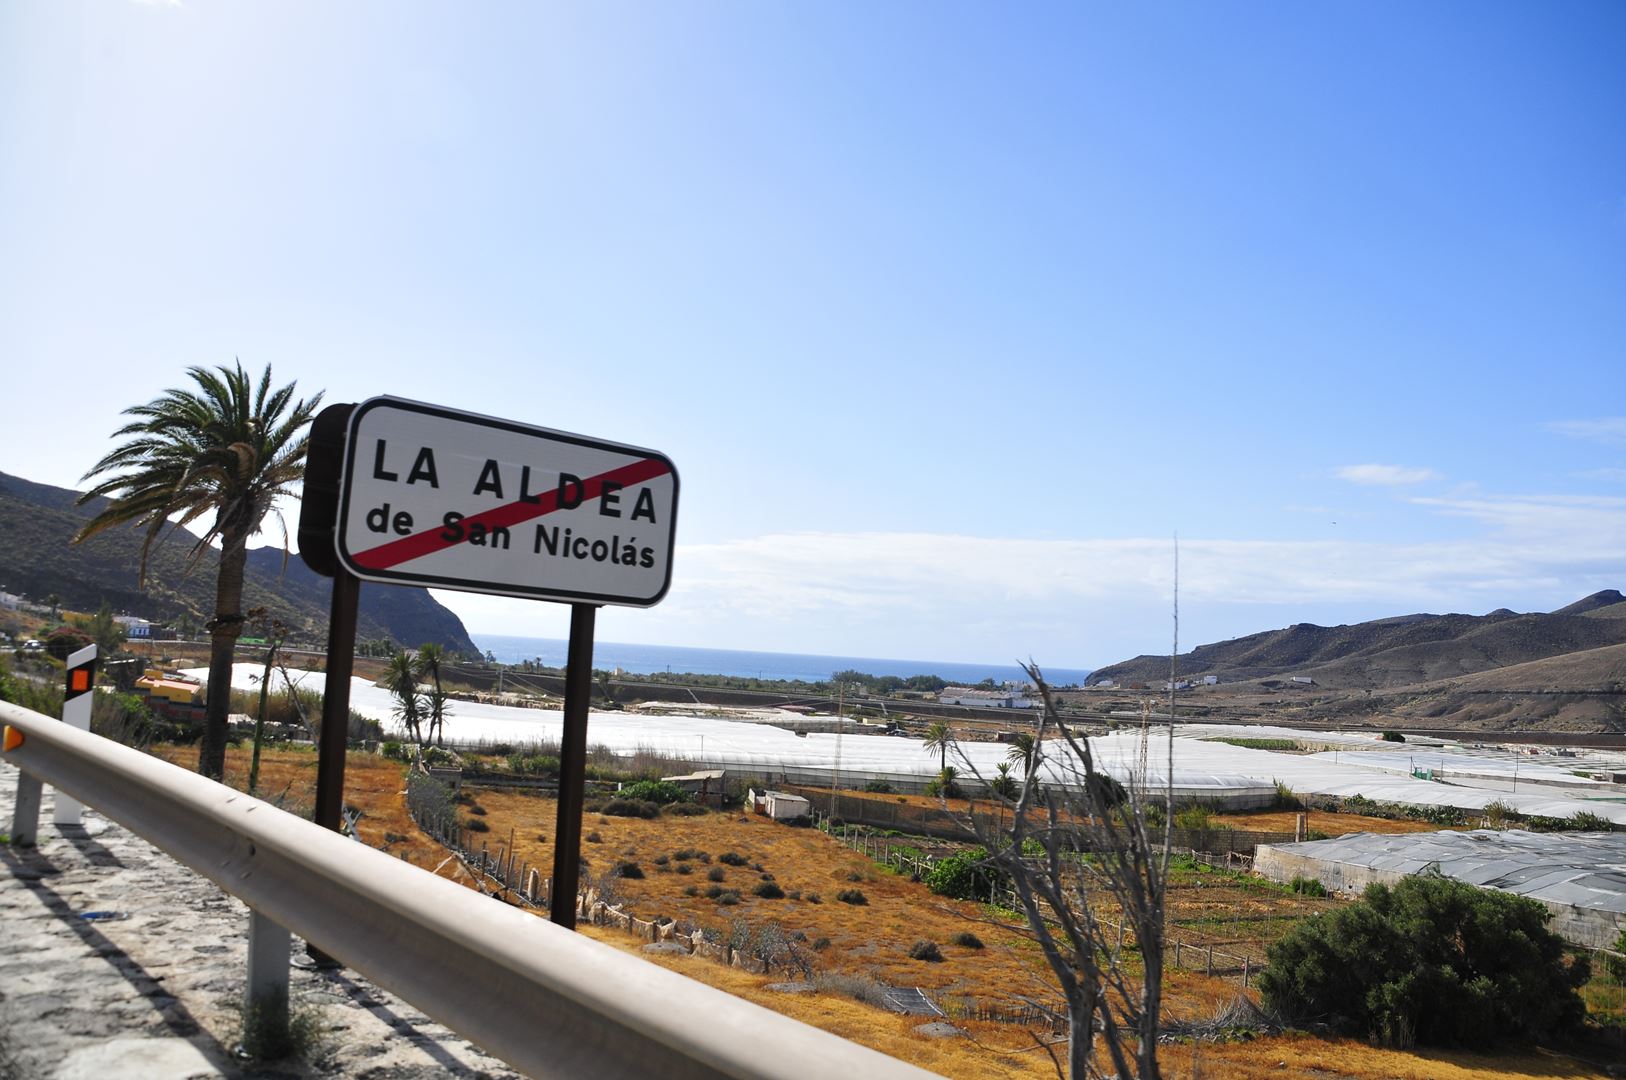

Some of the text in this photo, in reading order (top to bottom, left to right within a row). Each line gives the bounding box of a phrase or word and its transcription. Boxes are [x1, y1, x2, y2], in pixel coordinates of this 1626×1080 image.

[373, 438, 657, 524] LA ALDEA
[366, 502, 655, 568] de San Nicolás
